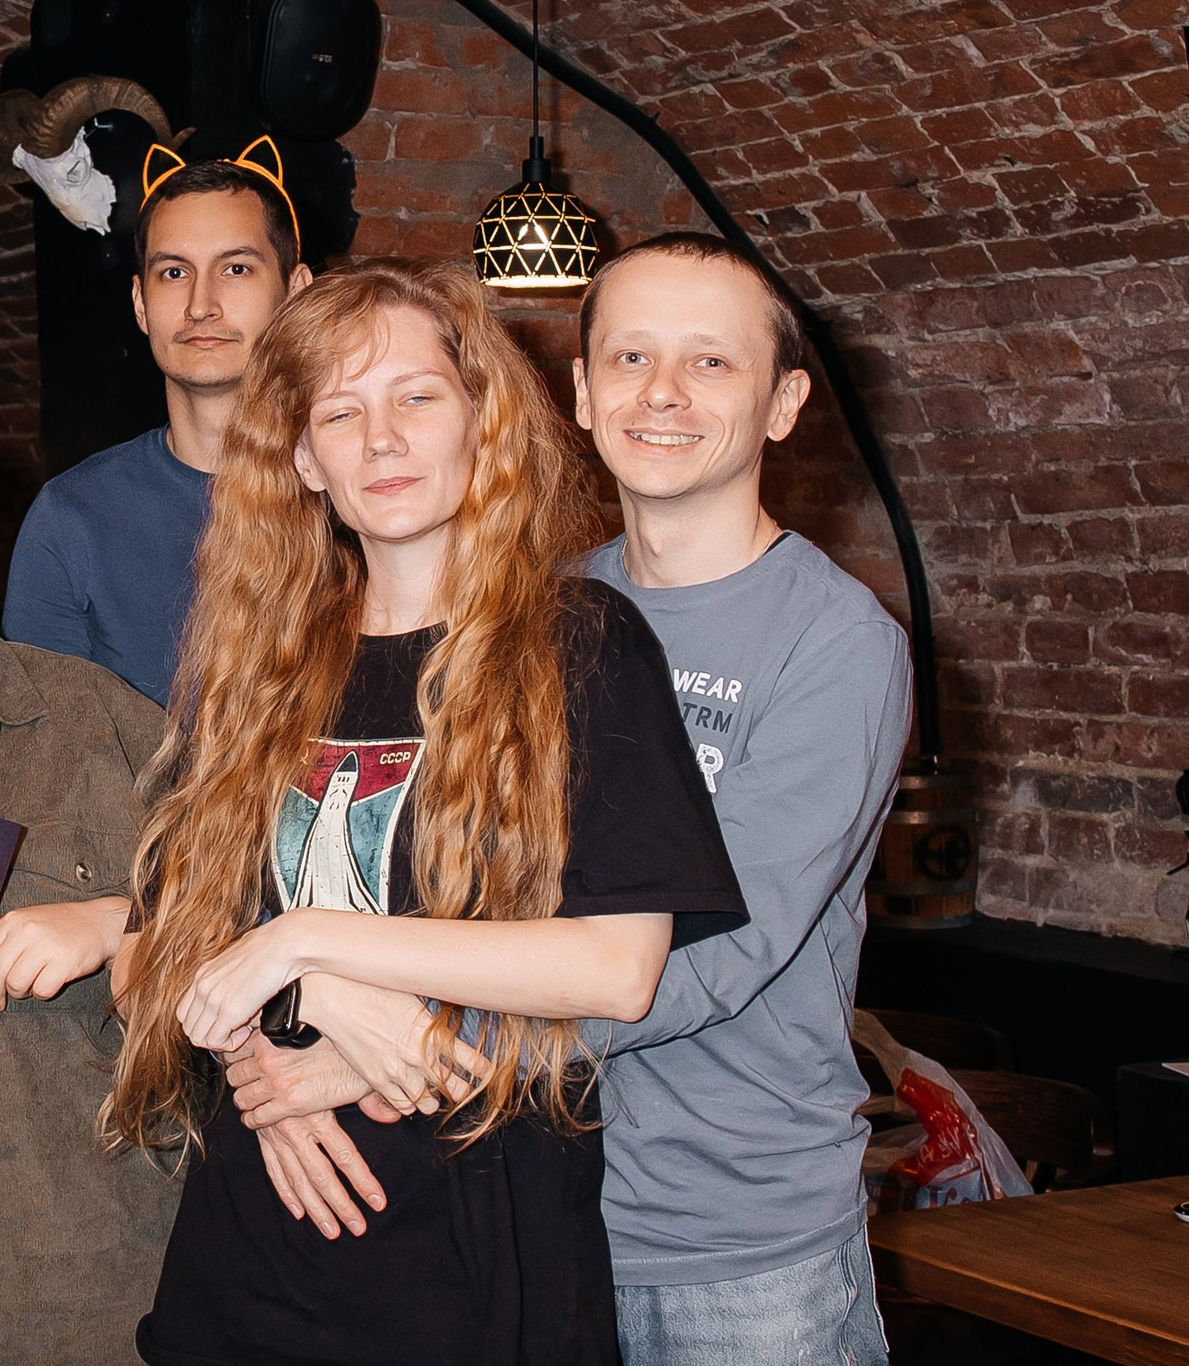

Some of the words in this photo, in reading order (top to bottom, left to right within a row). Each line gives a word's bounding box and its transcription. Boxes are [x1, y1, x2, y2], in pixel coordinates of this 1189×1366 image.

[672, 668, 743, 703] WEAR
[681, 701, 733, 734] TRM
[379, 751, 411, 765] СССР
